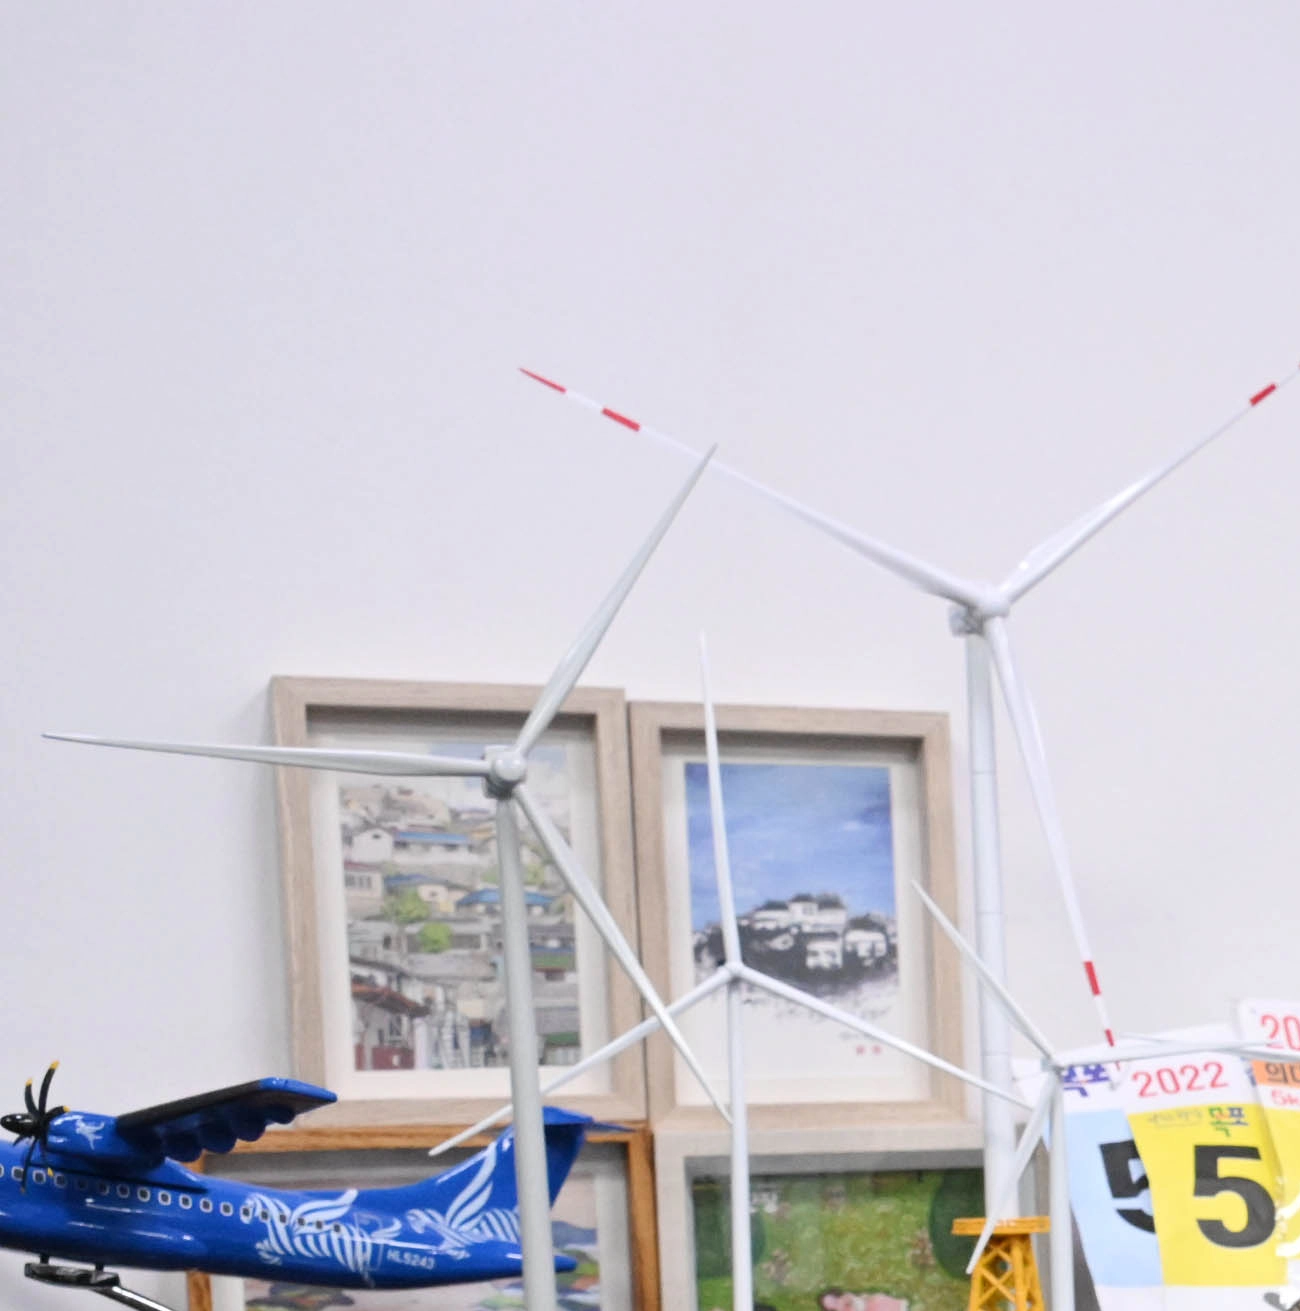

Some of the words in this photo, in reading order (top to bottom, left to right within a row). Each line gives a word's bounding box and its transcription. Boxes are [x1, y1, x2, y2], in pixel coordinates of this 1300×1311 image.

[1132, 1061, 1229, 1099] 2022
[1208, 1107, 1249, 1137] 목포
[1193, 1145, 1276, 1249] 5
